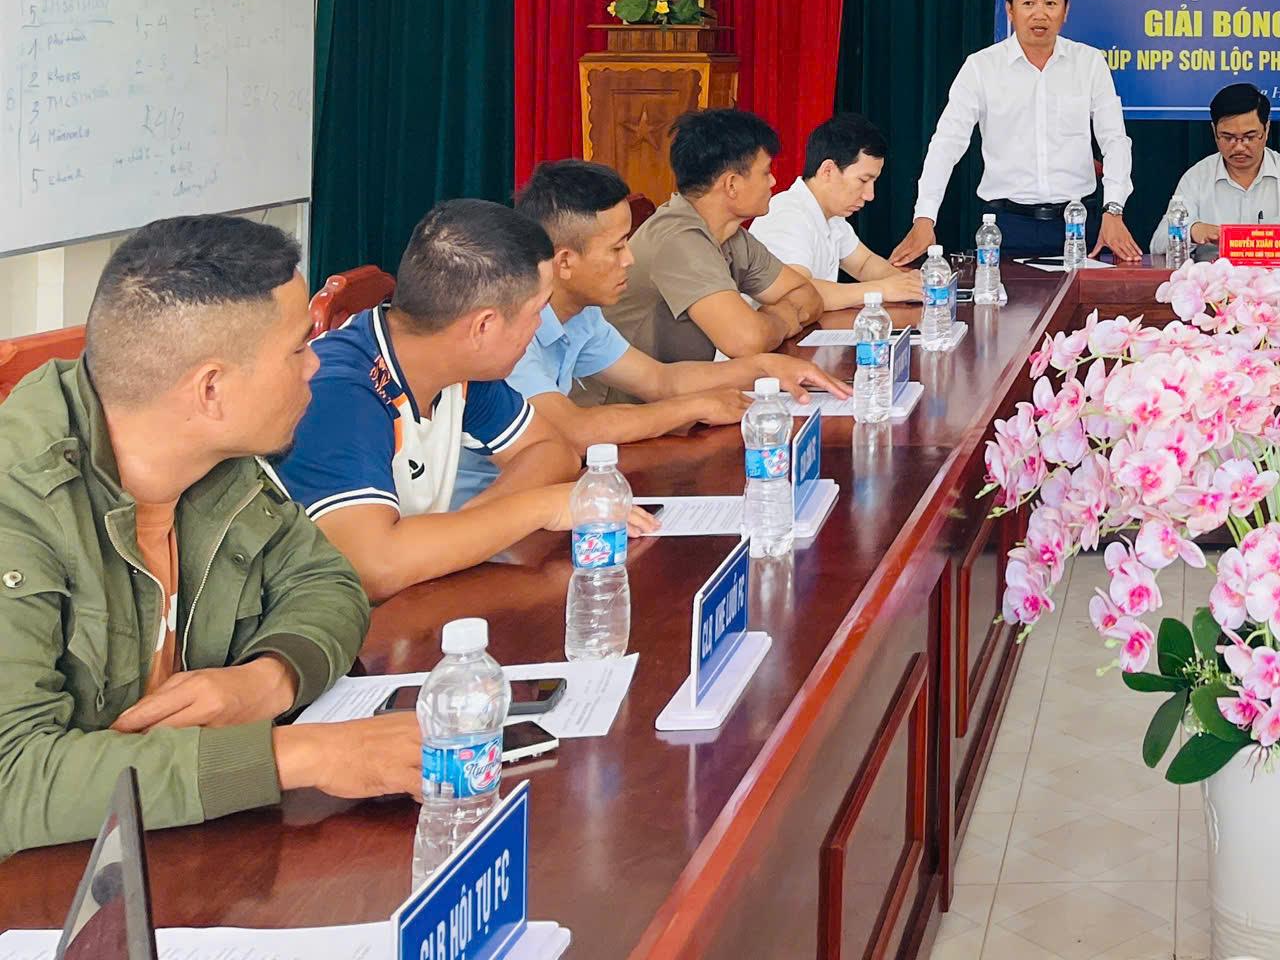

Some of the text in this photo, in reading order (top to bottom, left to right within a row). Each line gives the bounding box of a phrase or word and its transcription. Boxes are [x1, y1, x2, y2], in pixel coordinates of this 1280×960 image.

[1144, 3, 1202, 37] GIẢI
[1137, 50, 1173, 70] NPP
[1178, 48, 1215, 71] SƠN
[1221, 46, 1253, 75] LỘC
[495, 848, 510, 911] FC
